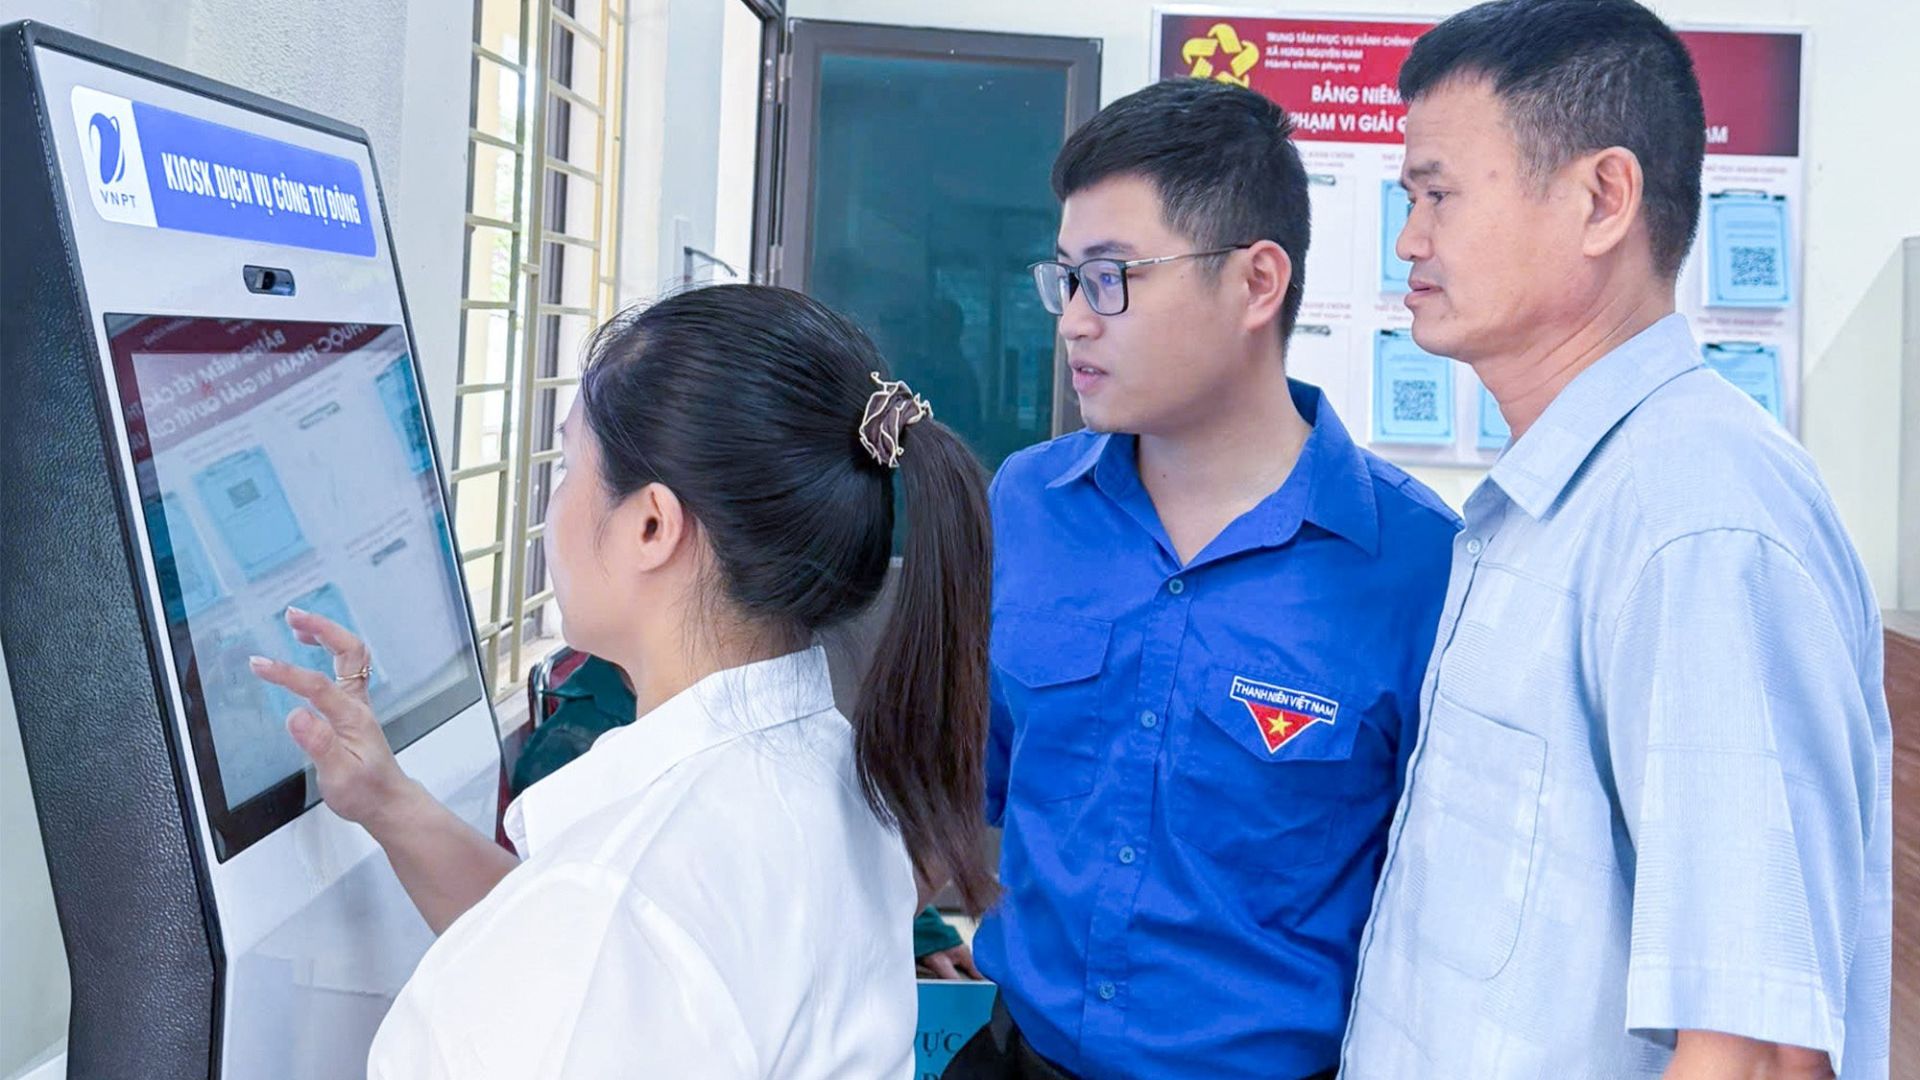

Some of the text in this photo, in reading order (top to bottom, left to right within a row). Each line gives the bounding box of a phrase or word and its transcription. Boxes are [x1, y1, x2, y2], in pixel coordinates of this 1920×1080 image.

[1311, 80, 1359, 104] BẢNG
[1338, 113, 1356, 132] VI
[1358, 109, 1394, 133] GIẢI
[1704, 125, 1728, 144] AM
[99, 188, 136, 209] VNPT
[161, 151, 362, 229] KIOSK DỊCH VỤ CÔNG TỰ ĐỘNG
[1235, 682, 1268, 700] THANH
[1290, 695, 1312, 711] VIỆT
[1310, 701, 1334, 717] NAM
[917, 1028, 963, 1058] ỰC
